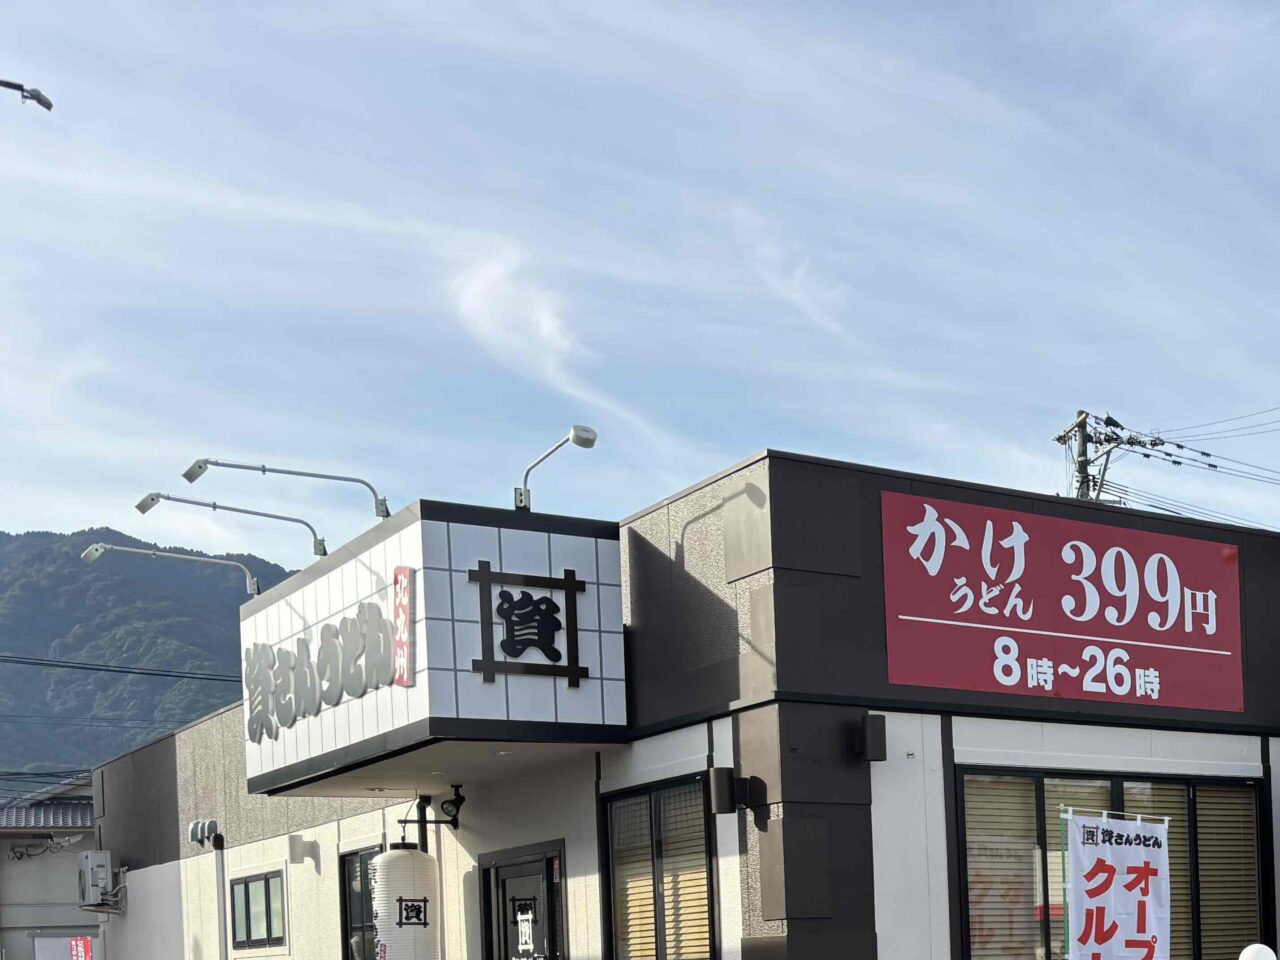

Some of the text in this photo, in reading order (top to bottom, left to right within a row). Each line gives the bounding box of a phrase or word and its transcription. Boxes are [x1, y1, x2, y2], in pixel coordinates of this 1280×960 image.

[905, 503, 1030, 583] かけ
[395, 573, 409, 682] 北九州
[949, 576, 1034, 621] うどん
[1061, 540, 1218, 636] 399円
[1101, 828, 1162, 849] 資さんうどん
